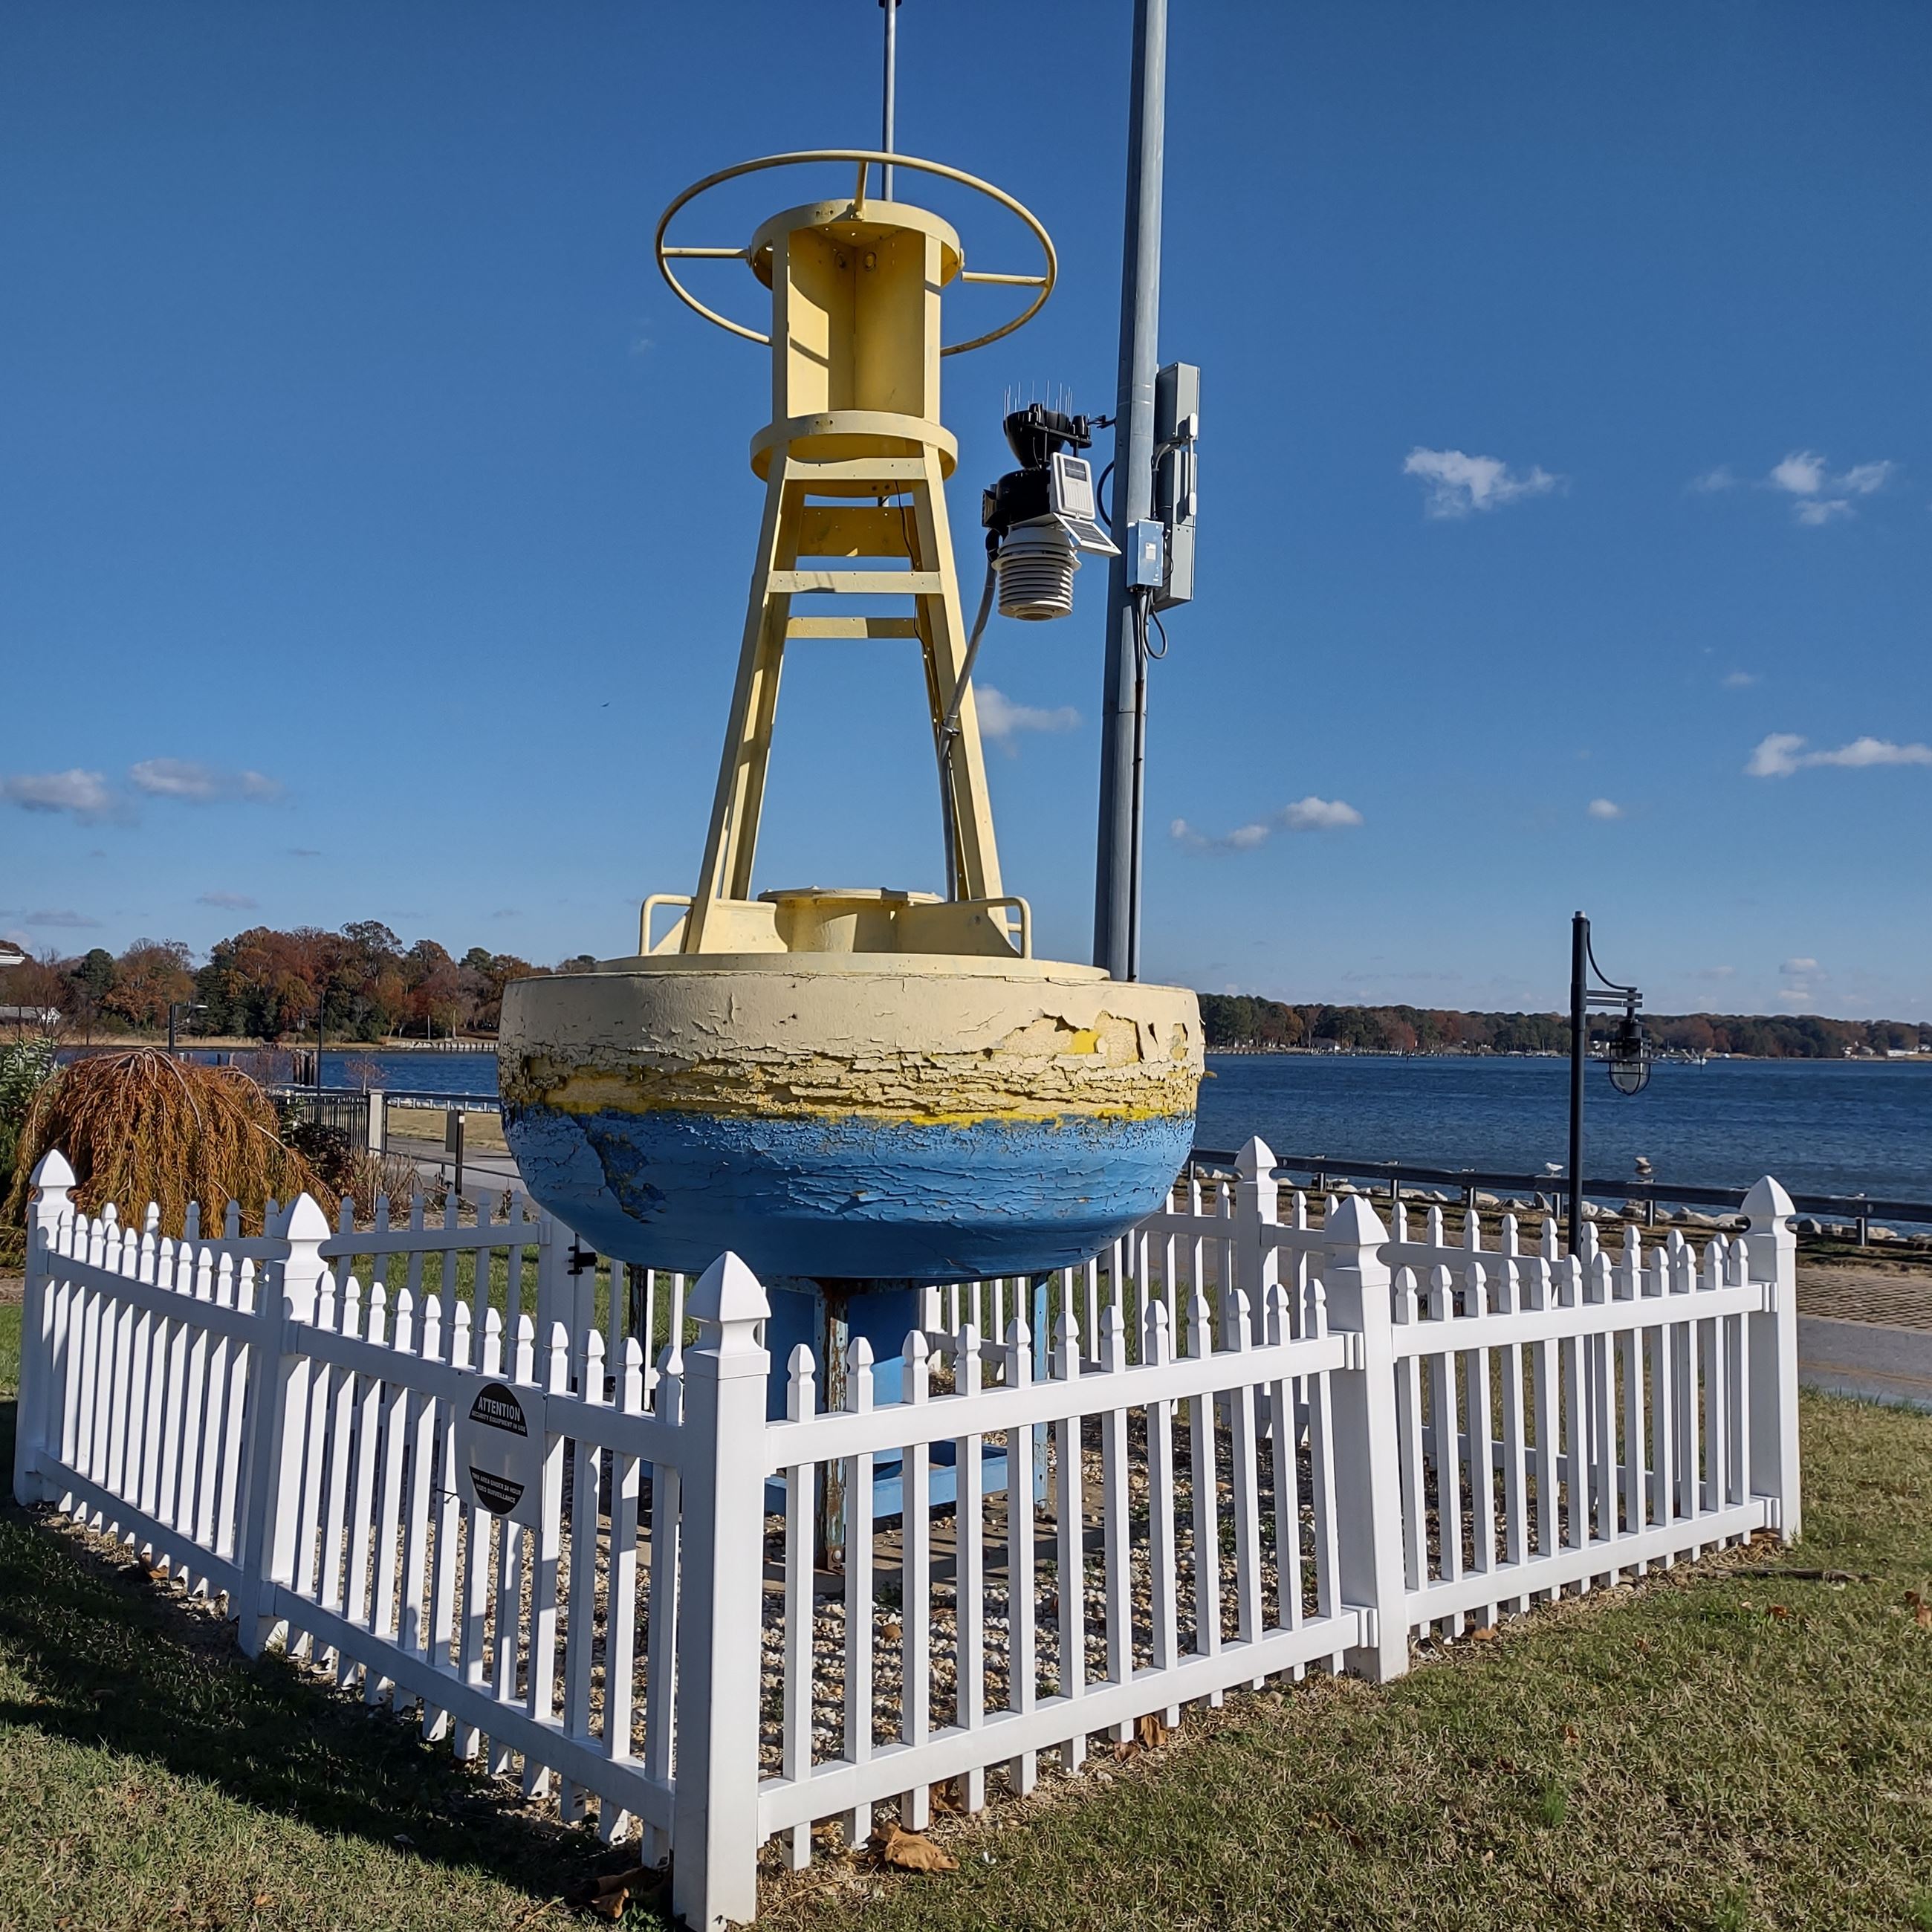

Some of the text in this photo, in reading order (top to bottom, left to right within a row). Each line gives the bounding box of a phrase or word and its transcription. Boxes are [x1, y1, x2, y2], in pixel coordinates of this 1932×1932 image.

[478, 1395, 520, 1422] ATTENTION
[471, 1410, 489, 1421] SECURITY
[518, 1424, 526, 1433] USE
[480, 1476, 490, 1484] AREA
